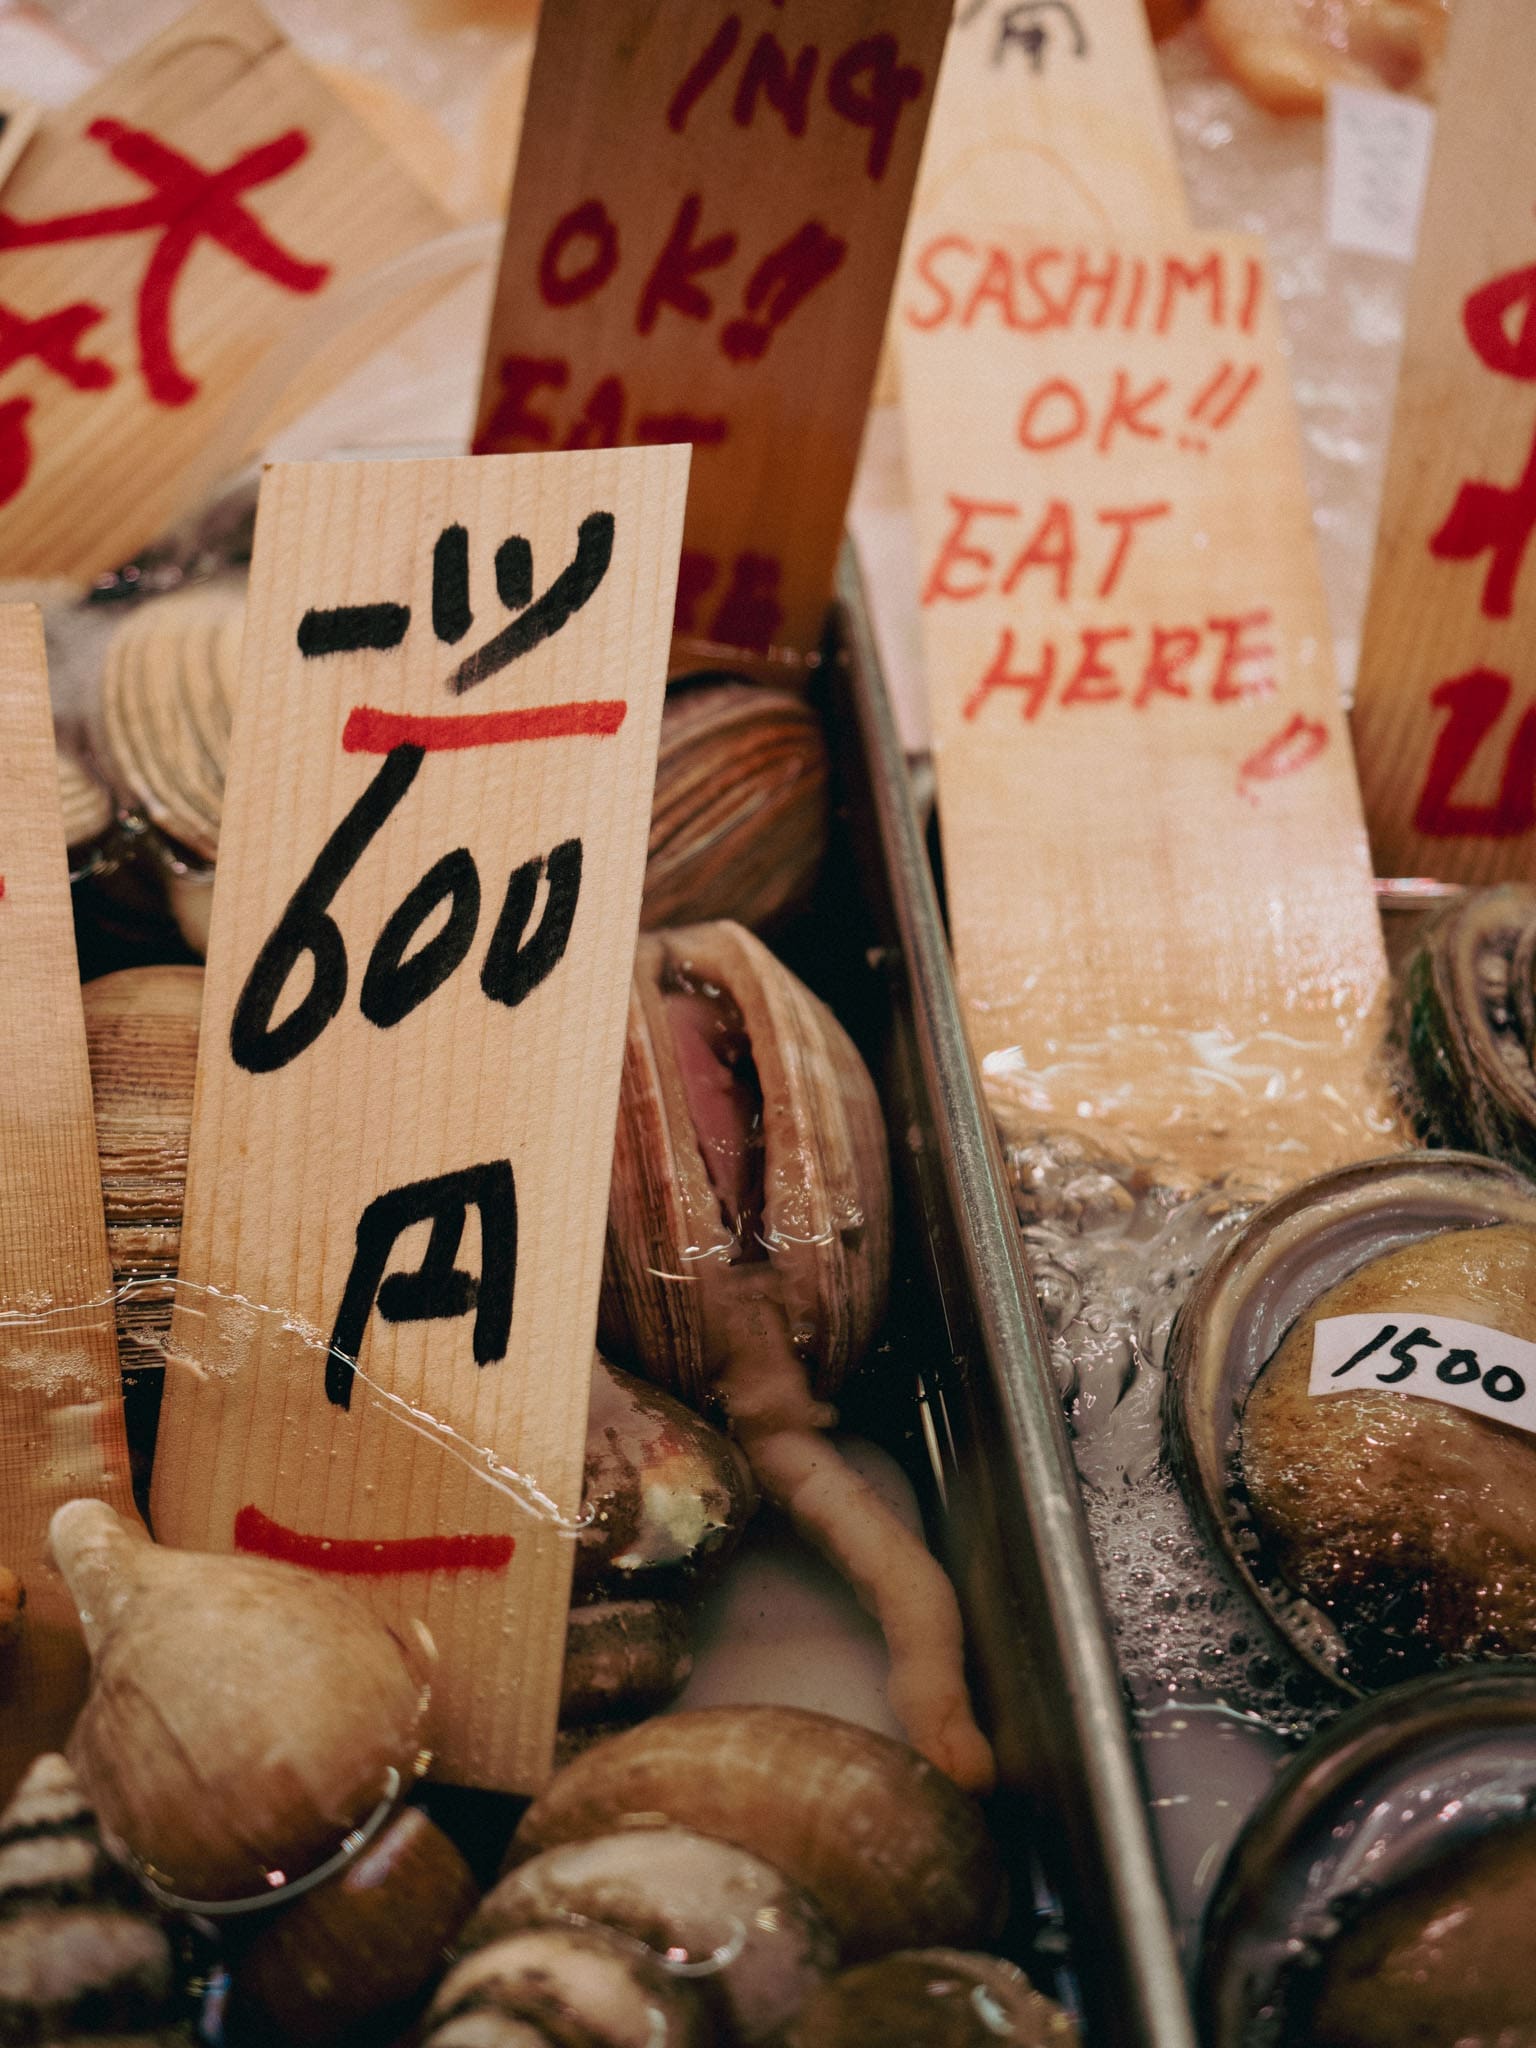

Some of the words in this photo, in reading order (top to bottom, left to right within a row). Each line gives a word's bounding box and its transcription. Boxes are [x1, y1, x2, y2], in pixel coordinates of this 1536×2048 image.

[906, 234, 1264, 336] SASHIMI
[1017, 362, 1262, 455] OK!!
[920, 492, 1172, 607] EAT
[962, 609, 1277, 723] HERE
[230, 742, 584, 1075] 600
[325, 1157, 518, 1412] 円
[1330, 1324, 1527, 1403] 1500
